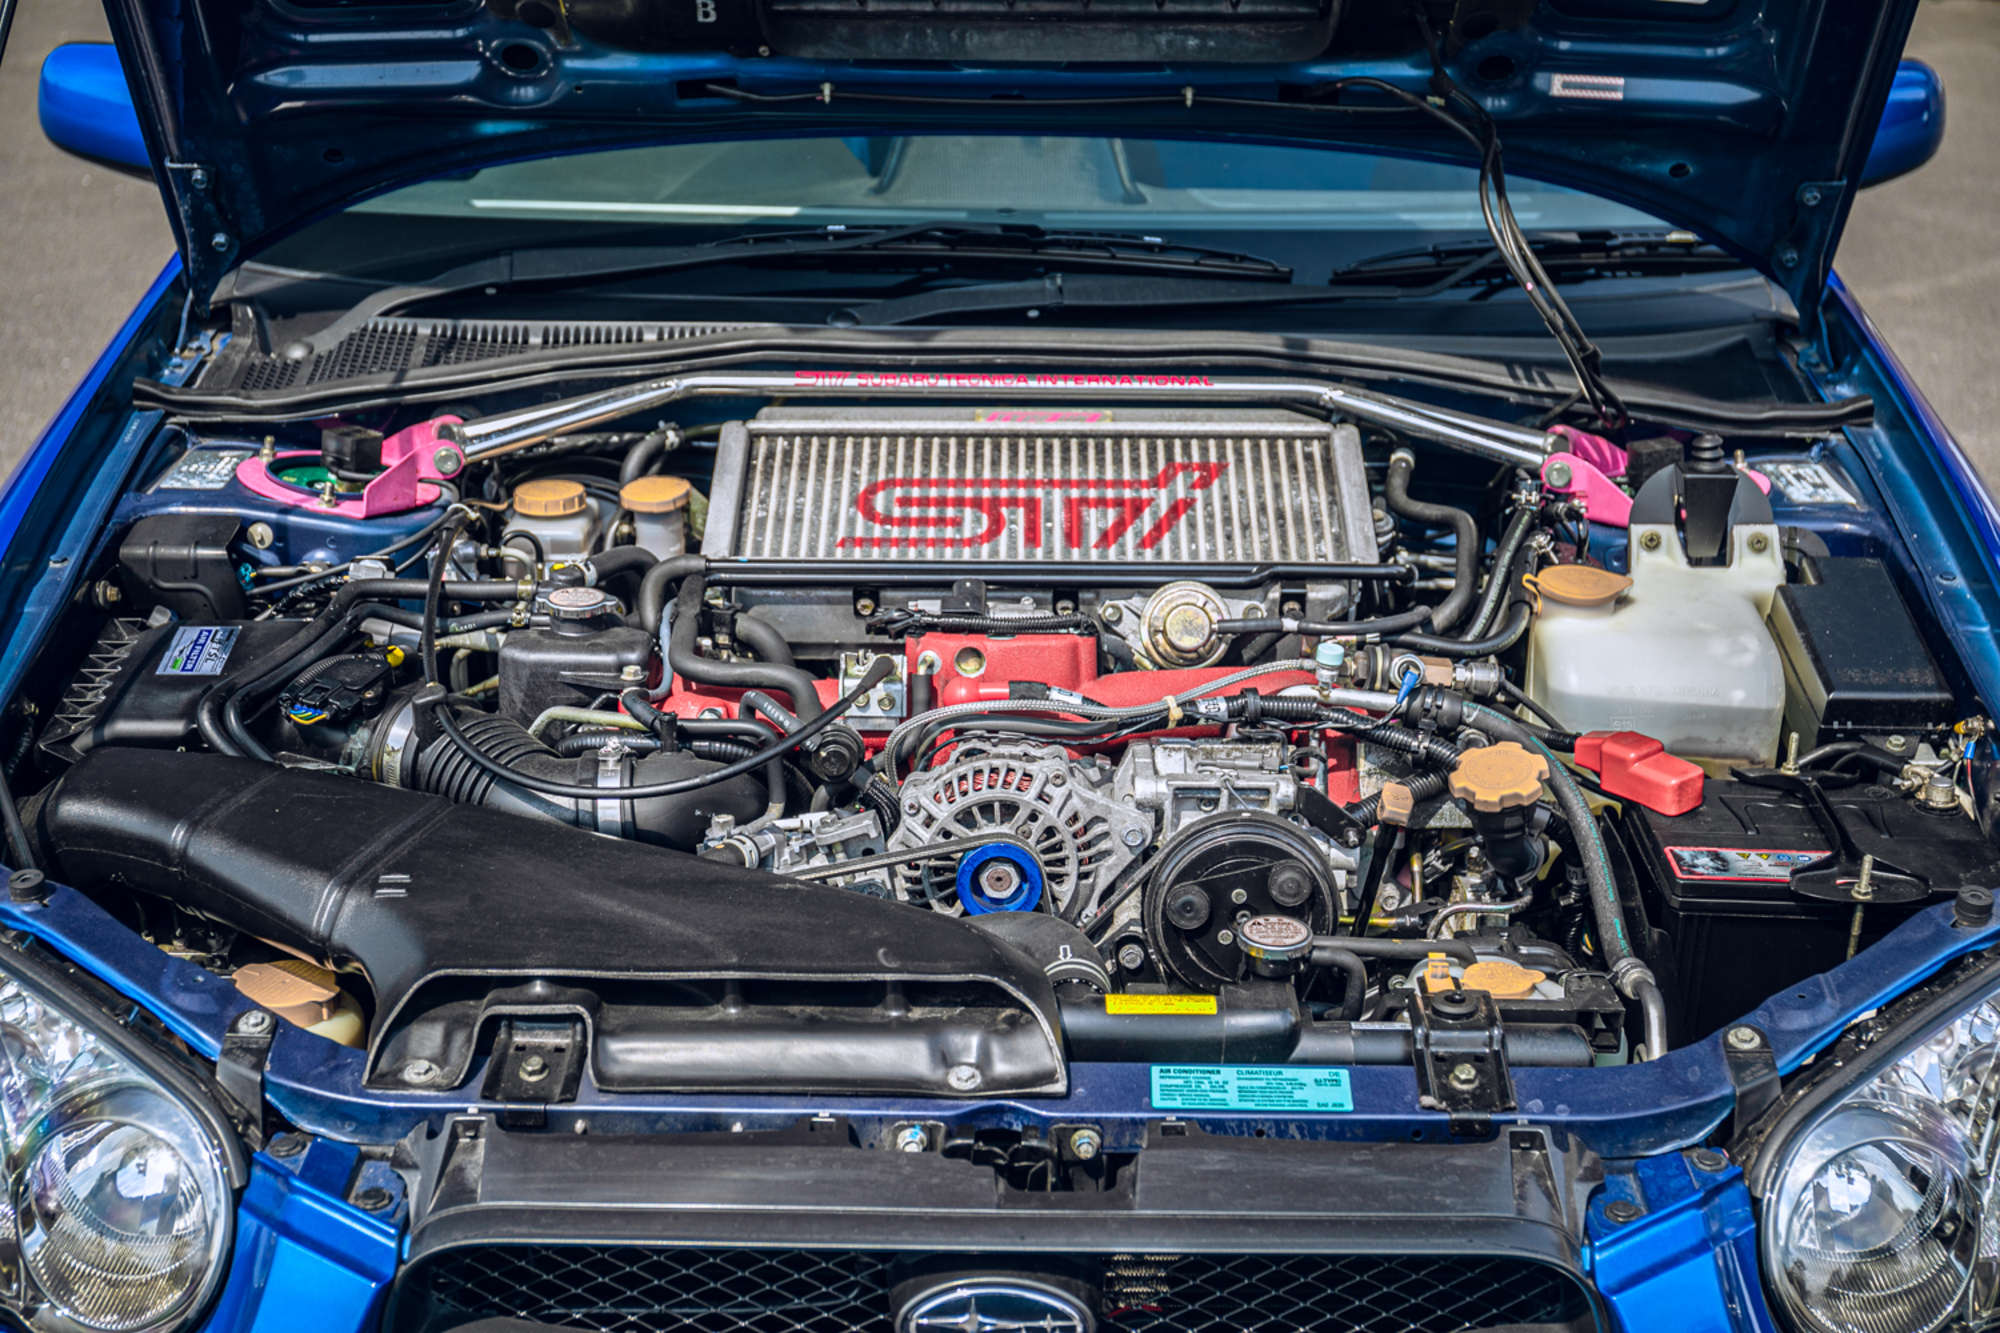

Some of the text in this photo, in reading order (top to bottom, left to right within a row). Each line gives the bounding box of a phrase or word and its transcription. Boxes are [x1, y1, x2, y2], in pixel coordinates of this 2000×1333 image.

[856, 373, 940, 387] SUBARU
[942, 373, 1029, 387] TECNICA
[1036, 374, 1215, 387] INTERNATIONAL
